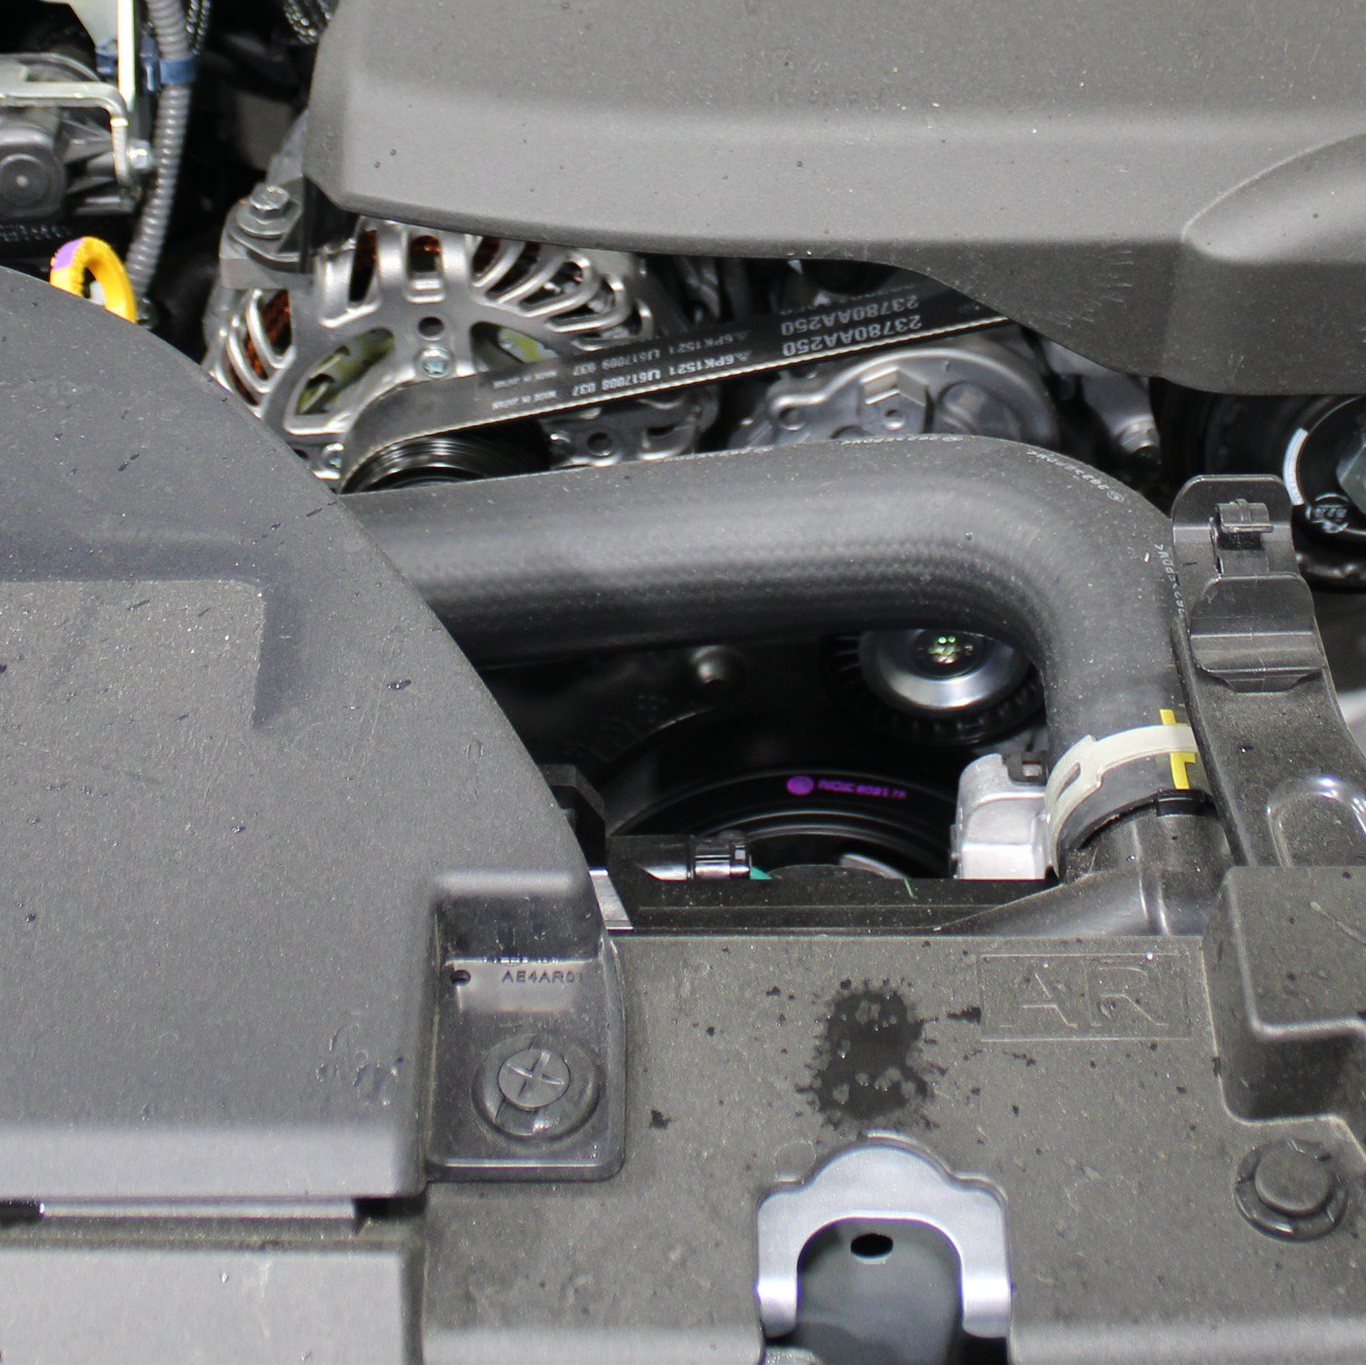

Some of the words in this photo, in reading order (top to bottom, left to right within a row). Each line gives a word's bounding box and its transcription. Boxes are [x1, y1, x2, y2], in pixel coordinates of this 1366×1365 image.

[780, 294, 920, 337] 23780AA250
[782, 314, 924, 357] 23780AA250
[669, 354, 735, 377] 6PK1521
[1000, 963, 1169, 1028] AR
